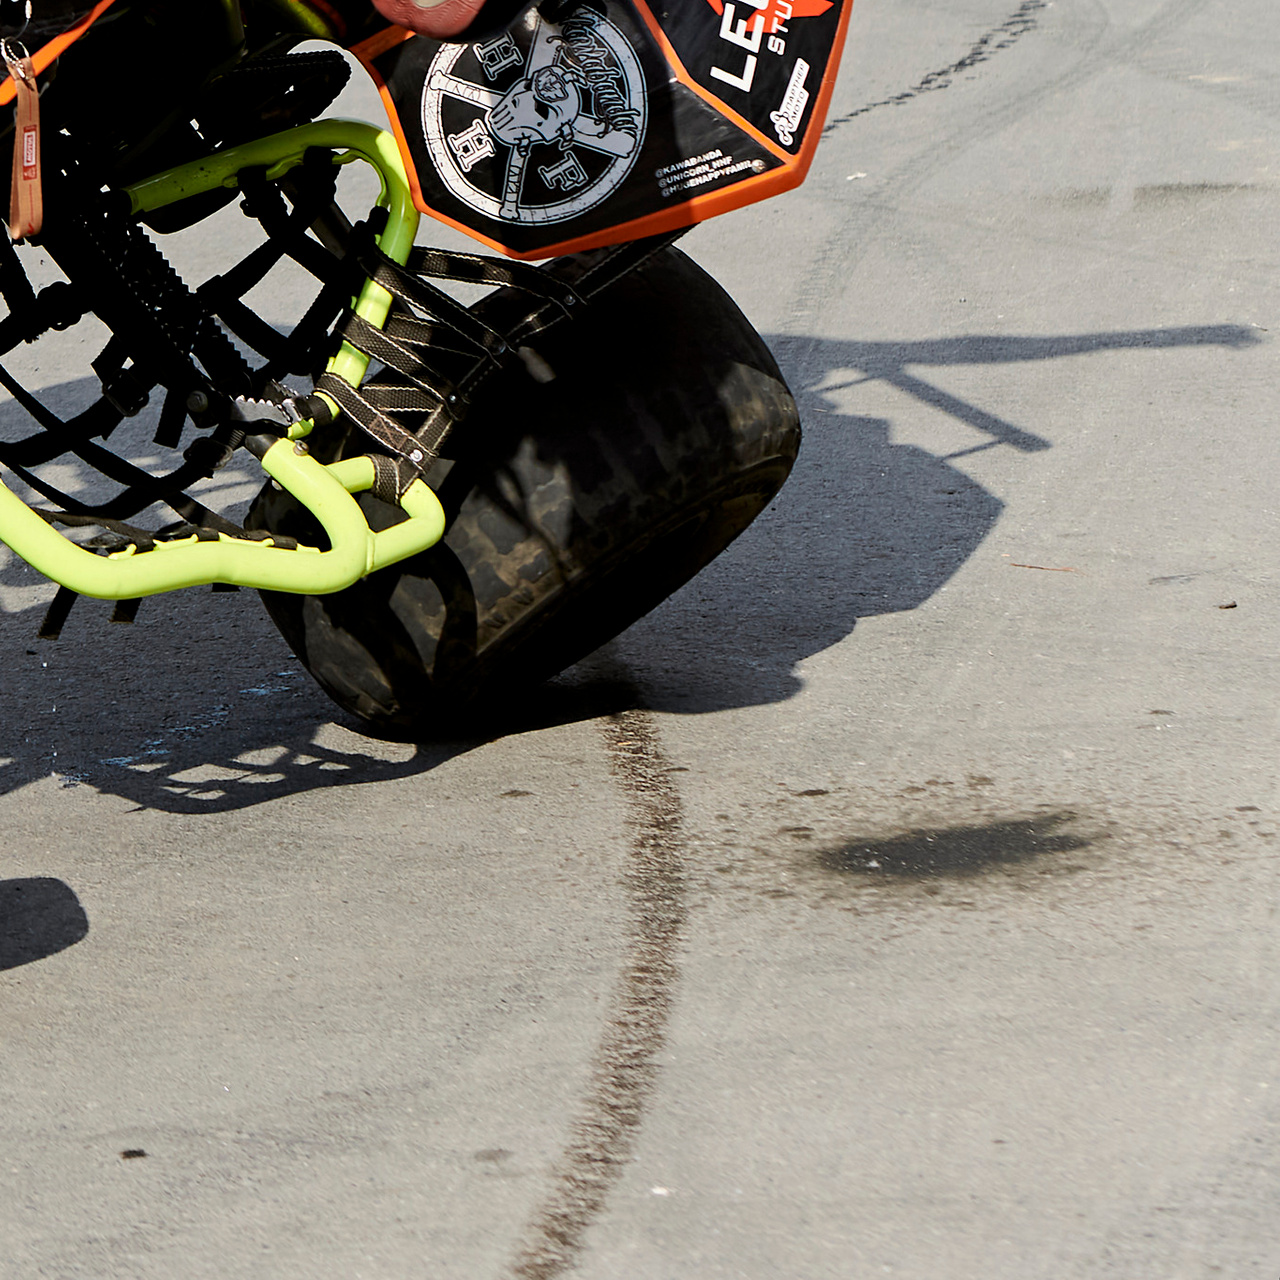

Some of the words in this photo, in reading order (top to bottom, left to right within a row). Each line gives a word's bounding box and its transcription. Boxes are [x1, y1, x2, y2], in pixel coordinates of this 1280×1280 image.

[785, 62, 806, 112] ПАРТНЕР
[790, 90, 806, 123] МОТО
[655, 148, 723, 178] @KAWABANDA
